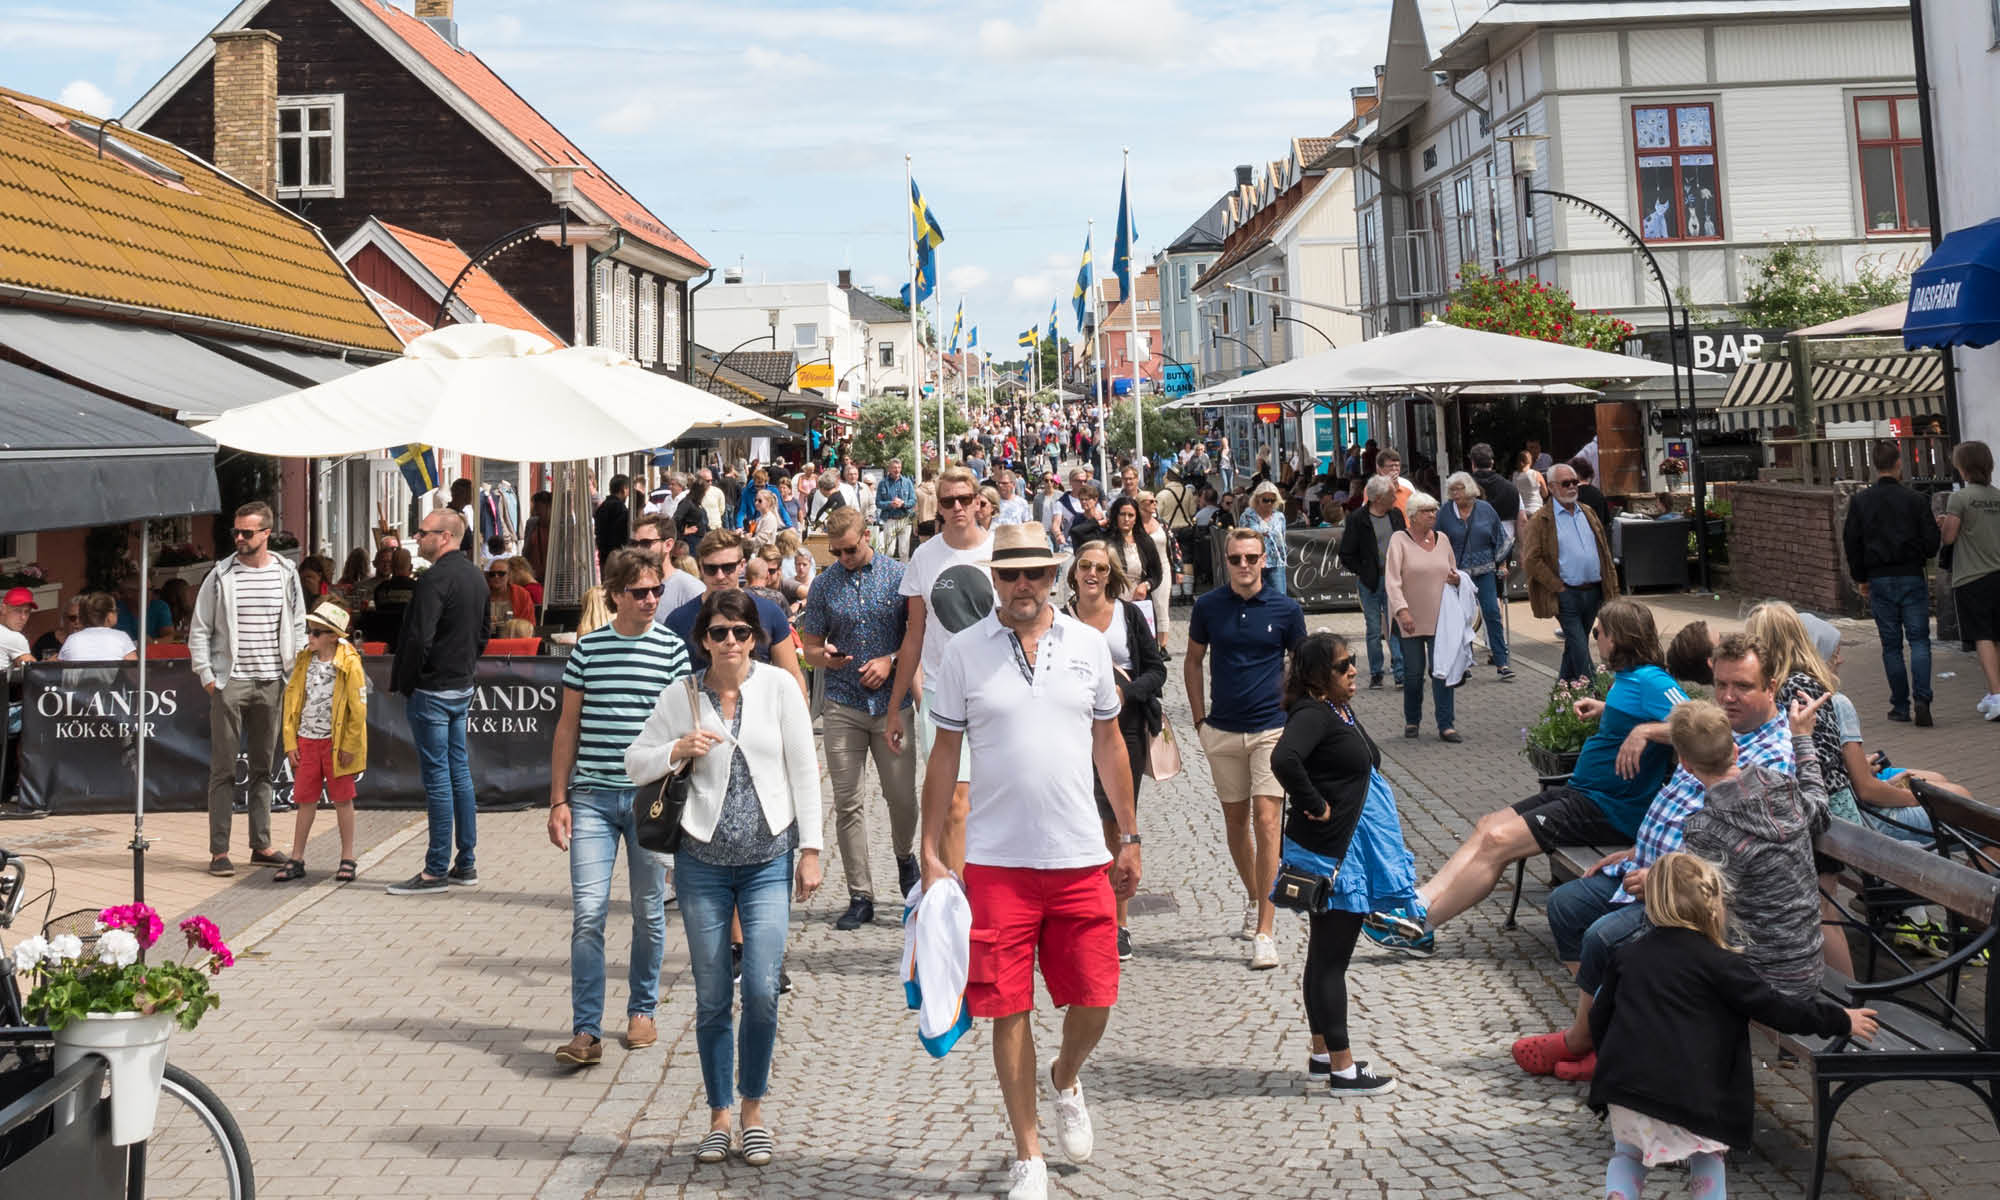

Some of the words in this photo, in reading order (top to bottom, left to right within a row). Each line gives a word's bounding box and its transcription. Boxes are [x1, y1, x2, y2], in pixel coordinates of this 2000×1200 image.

[37, 685, 177, 717] ÖLANDS
[467, 685, 556, 711] ANDS
[56, 719, 96, 738] KÖK
[99, 722, 115, 738] &
[482, 716, 498, 733] &
[502, 716, 538, 733] BAR
